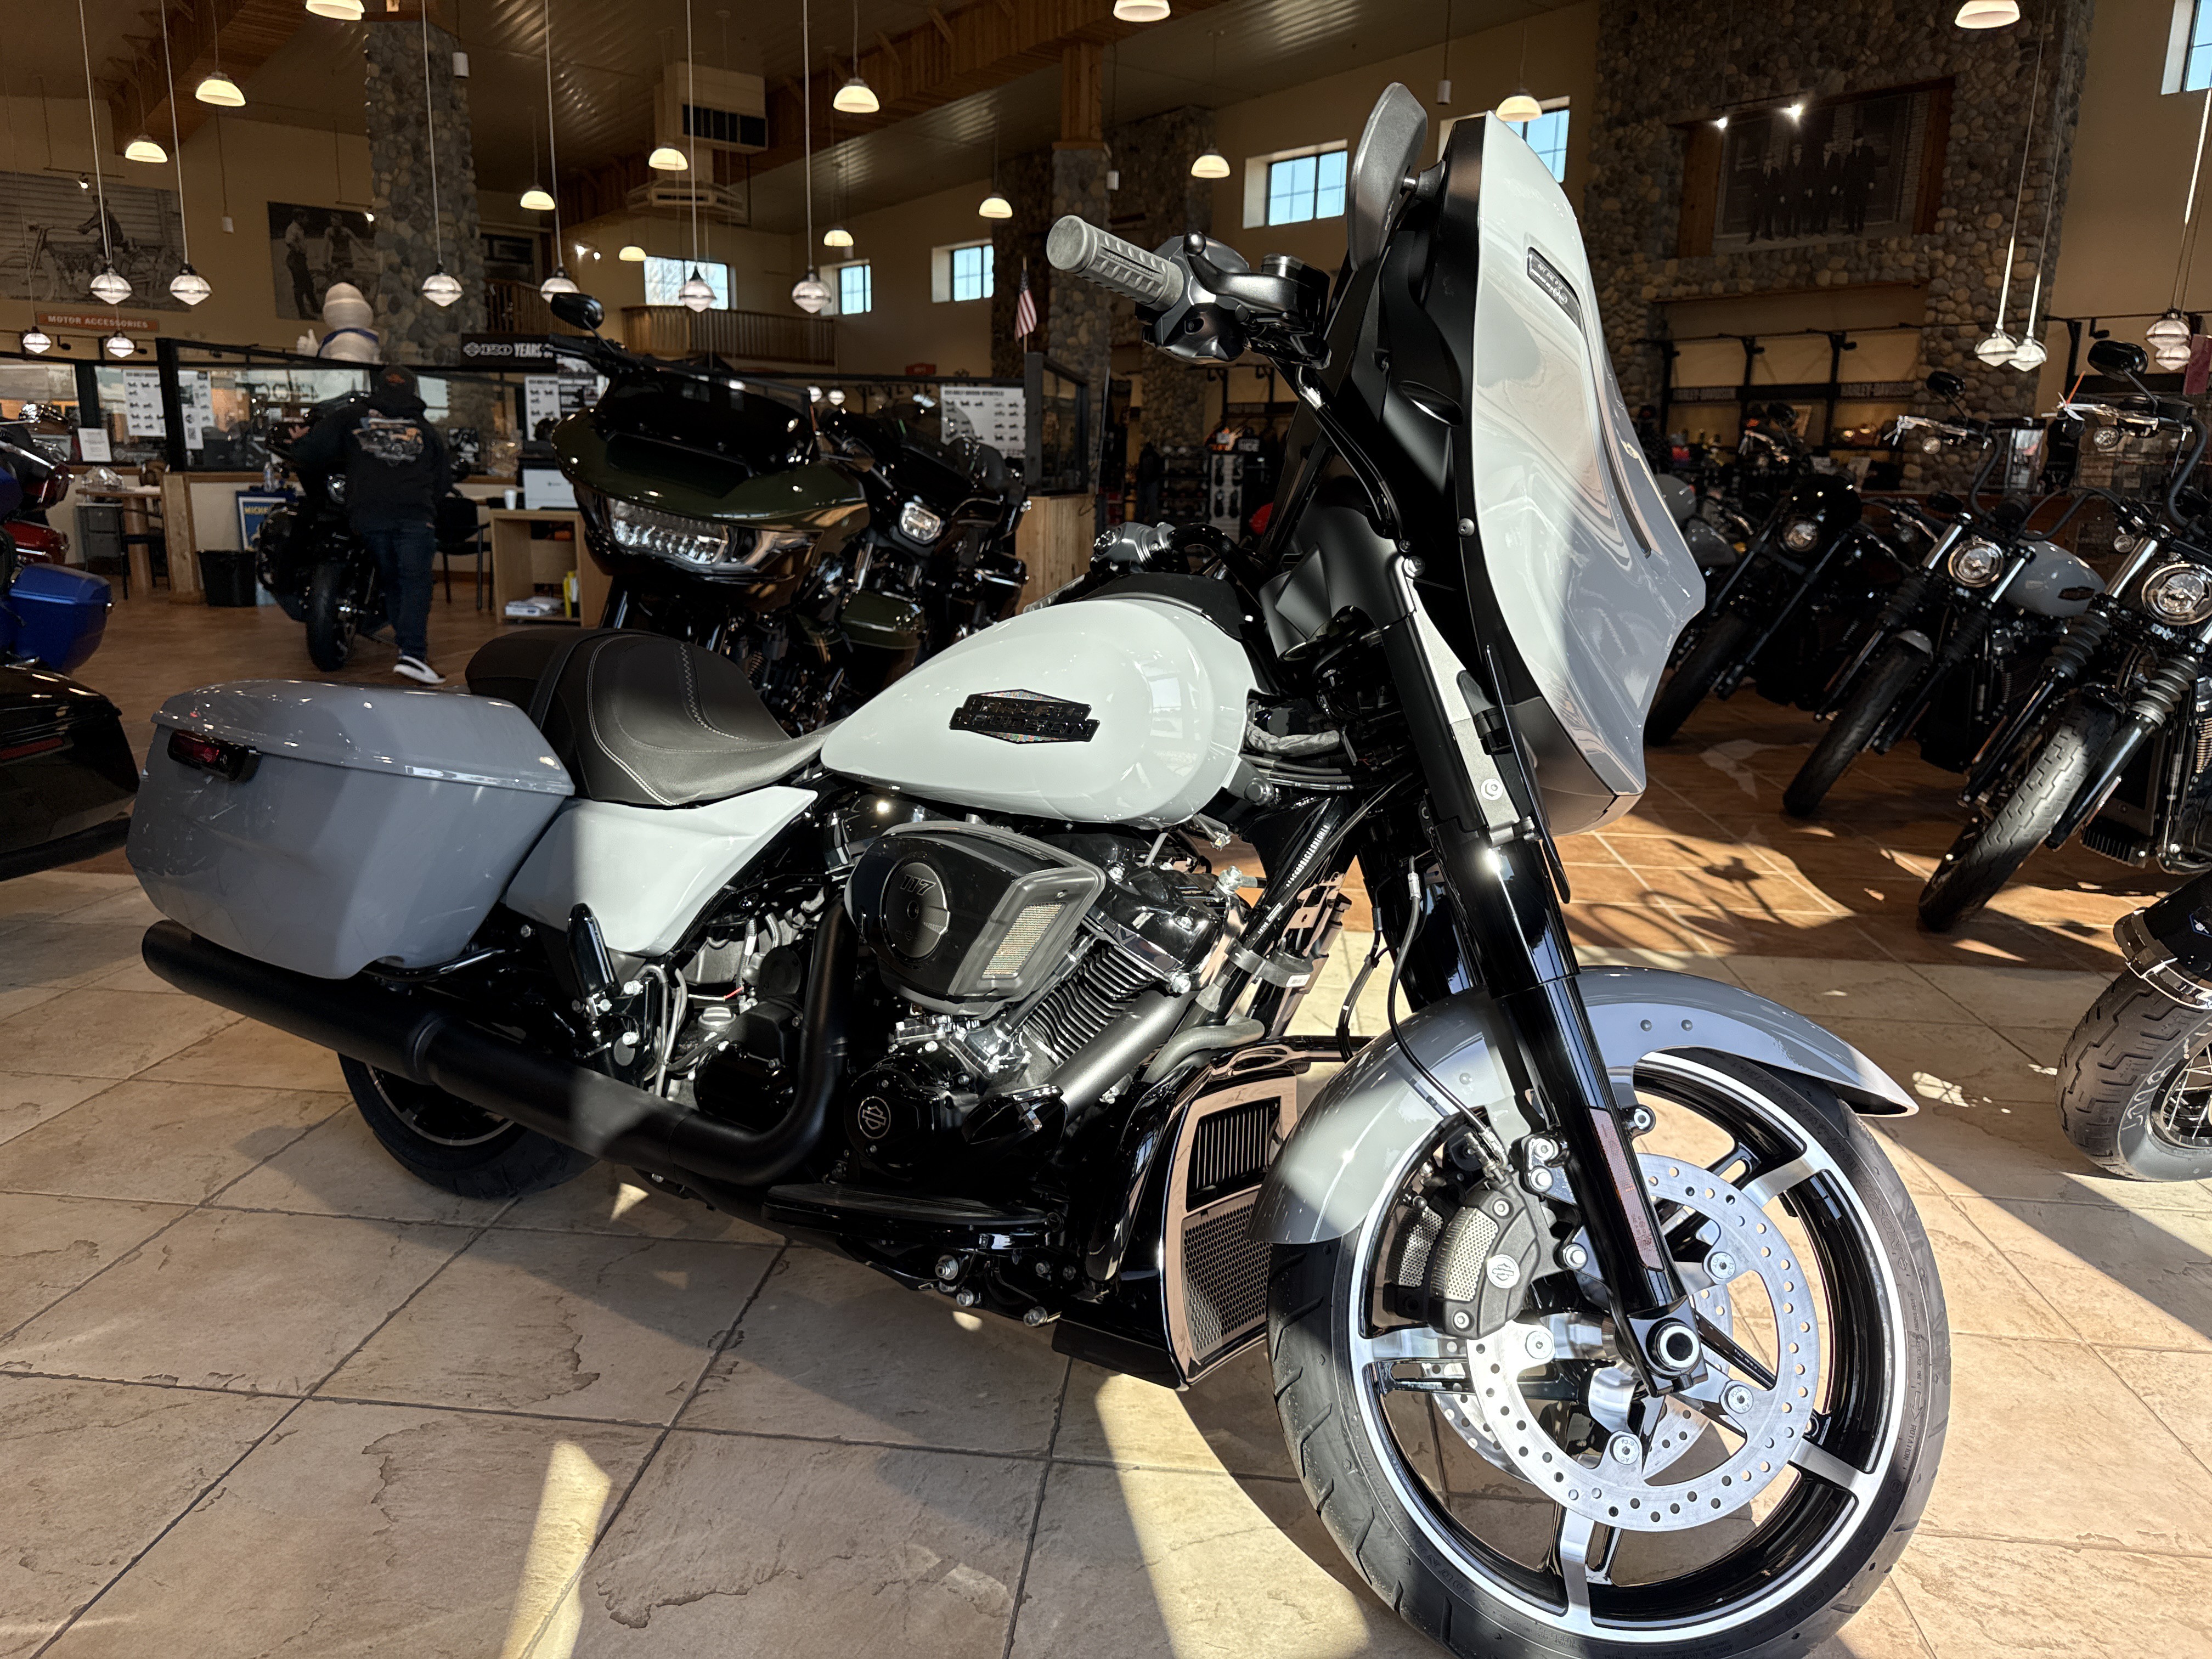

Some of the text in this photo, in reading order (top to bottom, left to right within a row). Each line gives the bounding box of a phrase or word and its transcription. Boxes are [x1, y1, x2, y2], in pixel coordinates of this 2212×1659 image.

[48, 315, 148, 329] MOTOR ACCESSORIES
[514, 342, 543, 358] YEARS
[900, 874, 936, 896] 117
[1901, 1424, 1917, 1462] ROTATION
[1389, 1509, 1469, 1594] DUNLOP
